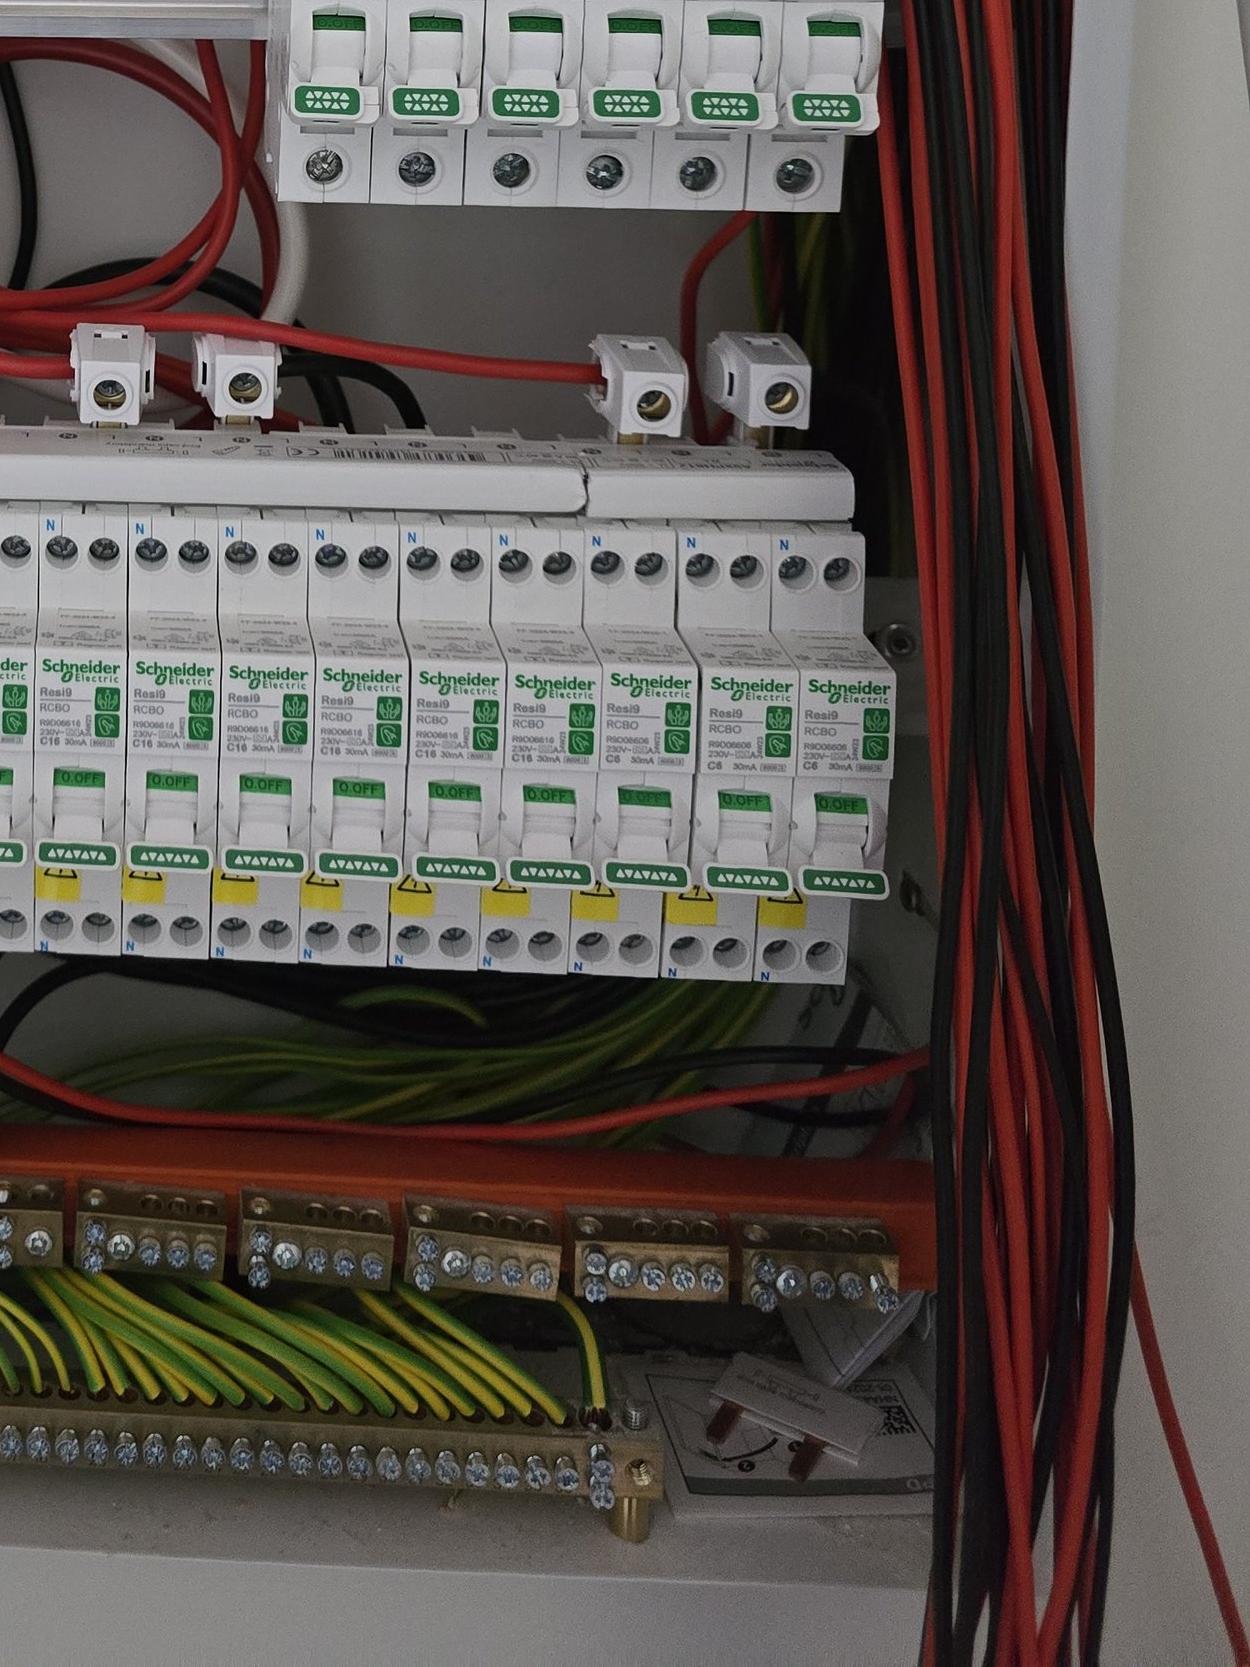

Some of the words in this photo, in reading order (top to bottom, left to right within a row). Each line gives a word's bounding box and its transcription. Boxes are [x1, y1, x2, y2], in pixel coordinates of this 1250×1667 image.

[42, 659, 120, 675] Schneider
[136, 661, 215, 677] Schneider
[229, 665, 308, 681] Schneider
[323, 668, 402, 683] Schneider
[419, 671, 500, 686] Schneider
[515, 674, 596, 690] Schneider
[611, 673, 692, 689] Schneider
[711, 677, 793, 692] Schneider
[808, 679, 890, 695] Schneider
[645, 689, 690, 698] Electric
[843, 695, 888, 704] Electric
[40, 703, 70, 713] RCBO
[133, 705, 164, 714] RCBO
[228, 710, 258, 719] RCBO
[321, 713, 352, 722] RCBO
[416, 715, 448, 725] RCBO
[513, 720, 544, 729] RCBO
[606, 720, 638, 729] RCBO
[709, 725, 741, 734] RCBO
[804, 727, 837, 737] RCBO
